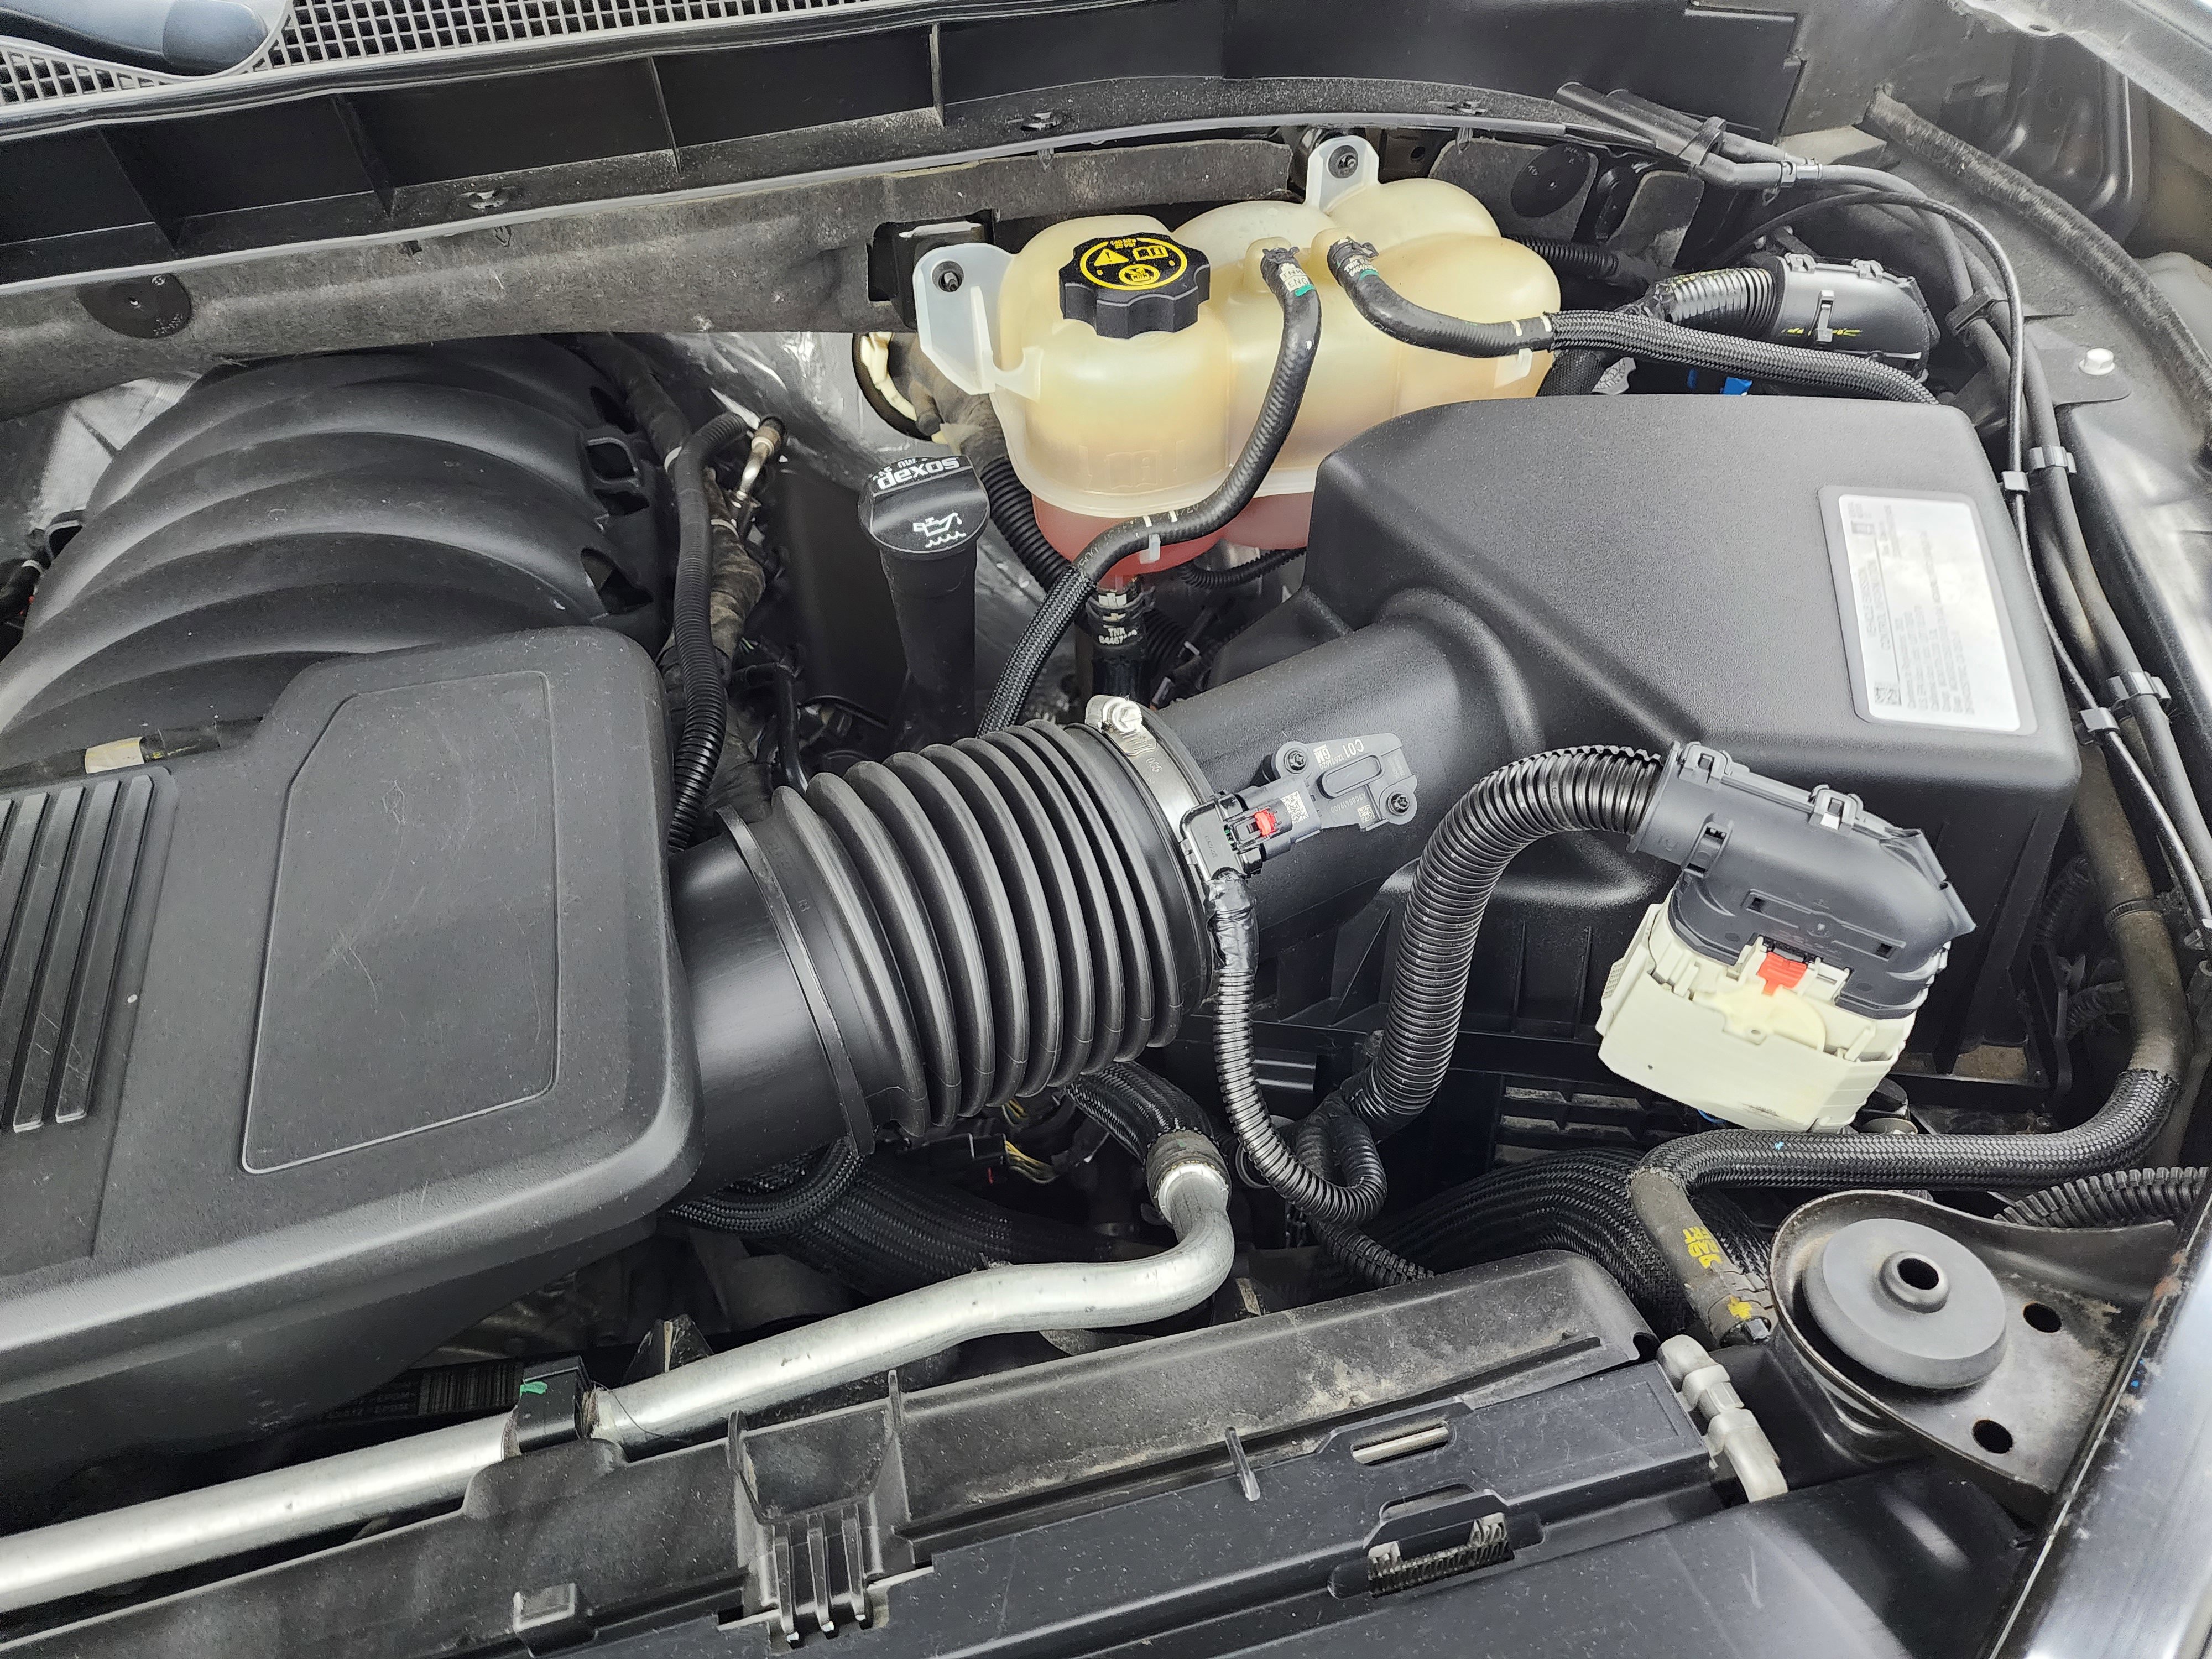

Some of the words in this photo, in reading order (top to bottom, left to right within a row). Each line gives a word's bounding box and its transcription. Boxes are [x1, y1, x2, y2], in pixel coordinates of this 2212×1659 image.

[1282, 269, 1304, 279] TNK
[1288, 278, 1308, 288] ENG
[877, 457, 959, 489] dexos
[1314, 747, 1331, 764] GM
[1342, 739, 1364, 759] C01
[1319, 754, 1344, 770] 12671620
[1688, 1239, 1720, 1258] RAD
